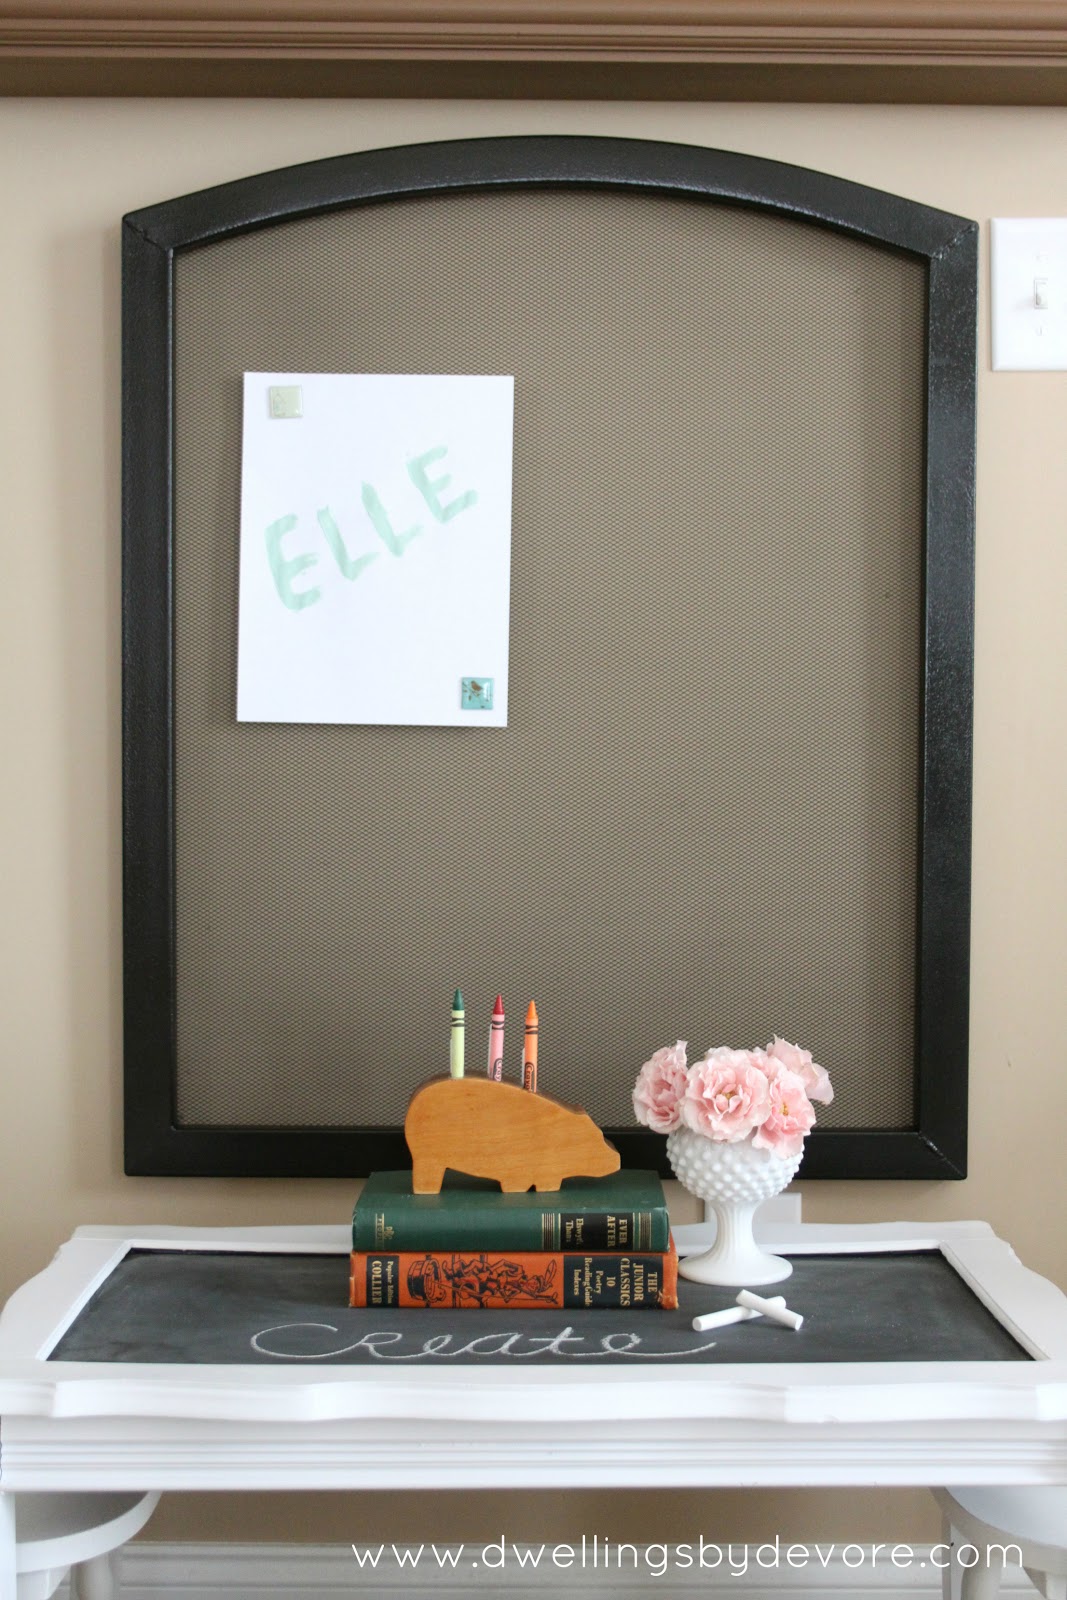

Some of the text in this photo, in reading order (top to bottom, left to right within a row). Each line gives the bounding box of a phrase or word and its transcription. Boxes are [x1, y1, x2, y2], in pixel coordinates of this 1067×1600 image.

[265, 444, 479, 613] ELLE
[607, 1215, 616, 1247] AFTER
[619, 1219, 628, 1244] EVER
[371, 1260, 382, 1304] COLLIER
[573, 1269, 582, 1296] Indexes
[582, 1257, 593, 1286] Reading
[594, 1270, 604, 1294] Poetry
[606, 1276, 616, 1287] 10
[620, 1258, 631, 1306] CLASSICS
[633, 1263, 644, 1301] JUNIOR
[647, 1271, 658, 1293] THE
[250, 1322, 716, 1359] Create
